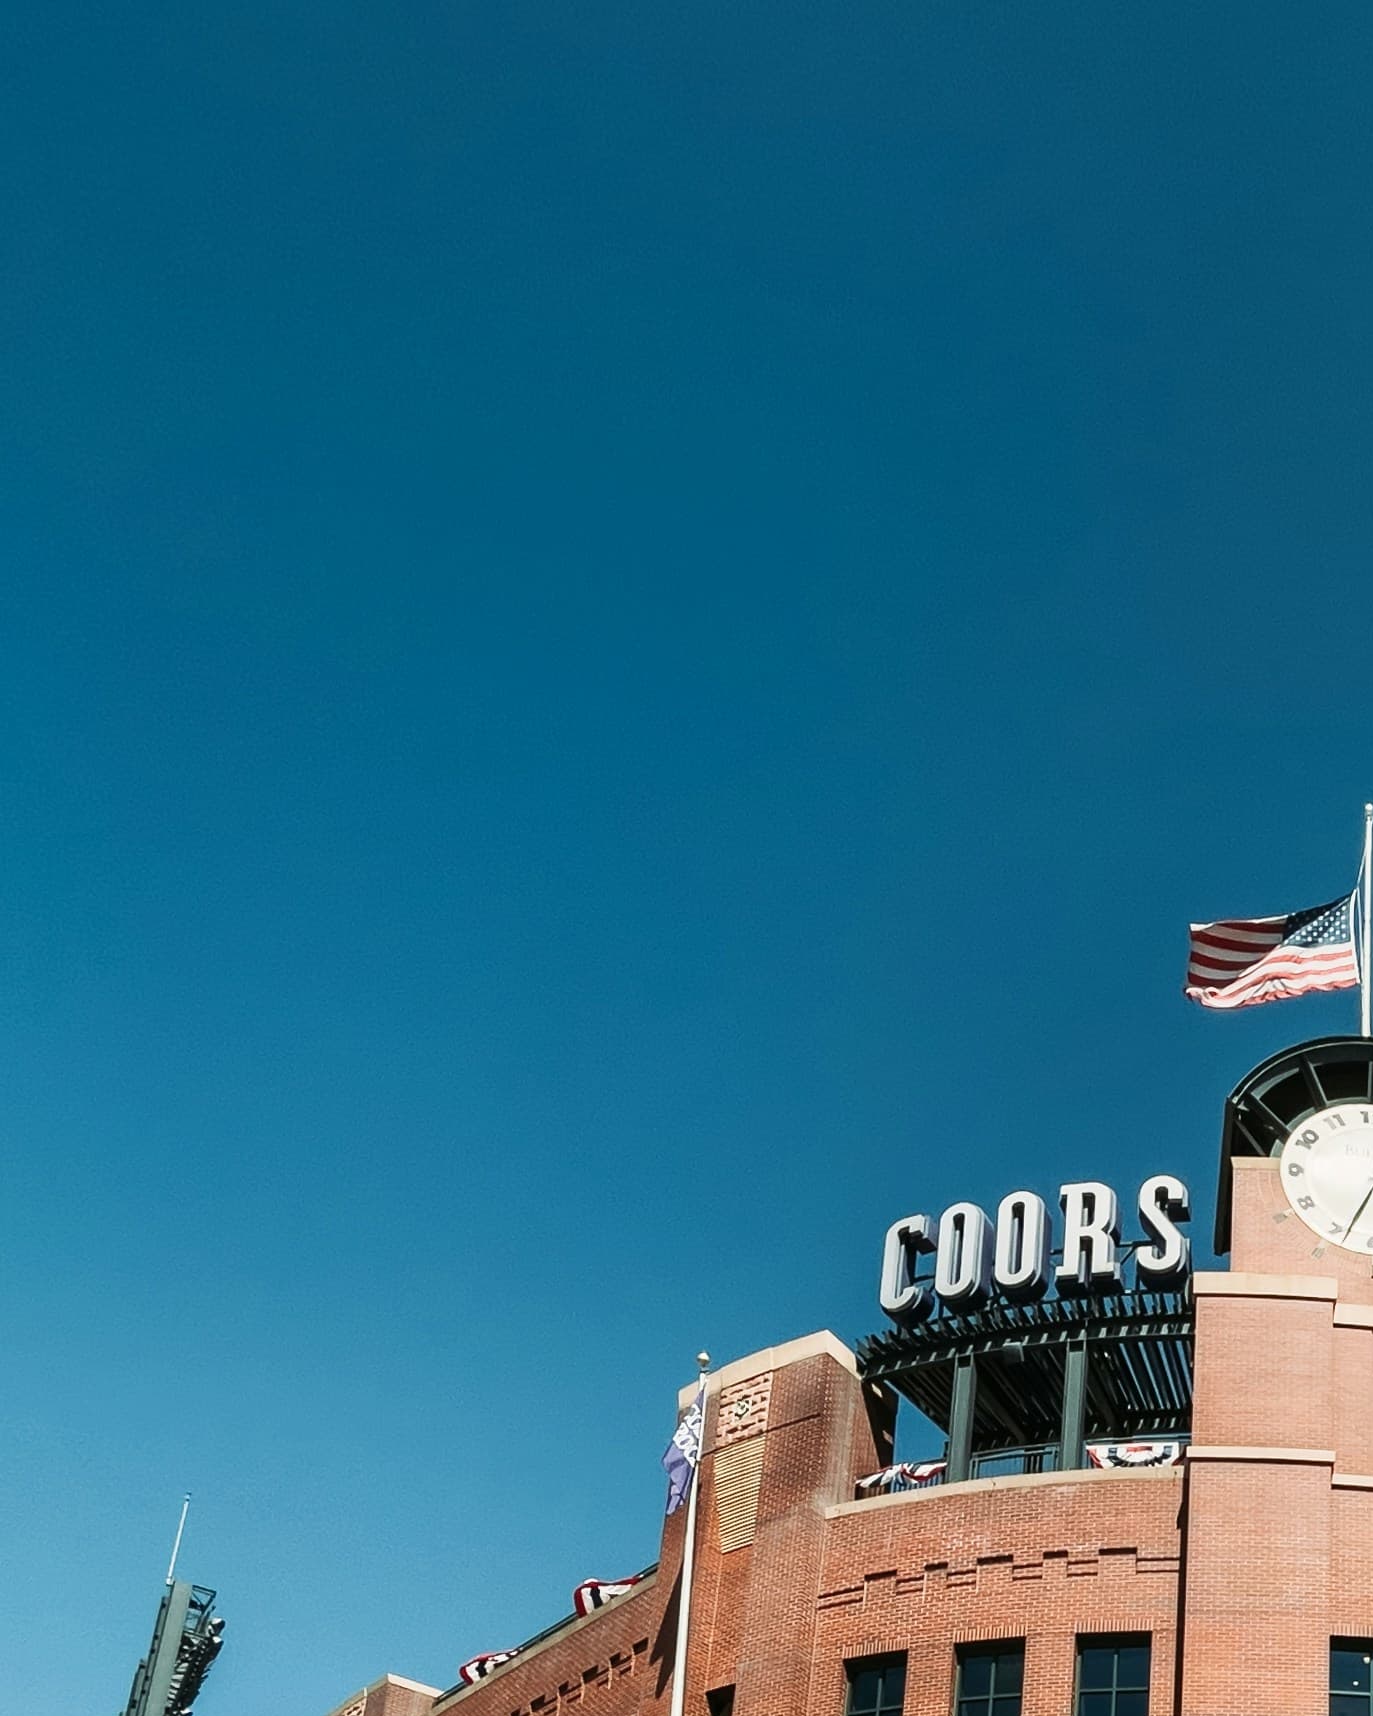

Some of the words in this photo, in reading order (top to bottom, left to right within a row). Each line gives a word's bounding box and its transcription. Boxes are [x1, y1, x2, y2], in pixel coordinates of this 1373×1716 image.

[1323, 1113, 1346, 1130] 11
[1295, 1129, 1320, 1150] 10
[1287, 1162, 1304, 1177] 9
[1297, 1195, 1315, 1210] 8
[1328, 1222, 1343, 1235] 7
[880, 1175, 1190, 1320] COORS
